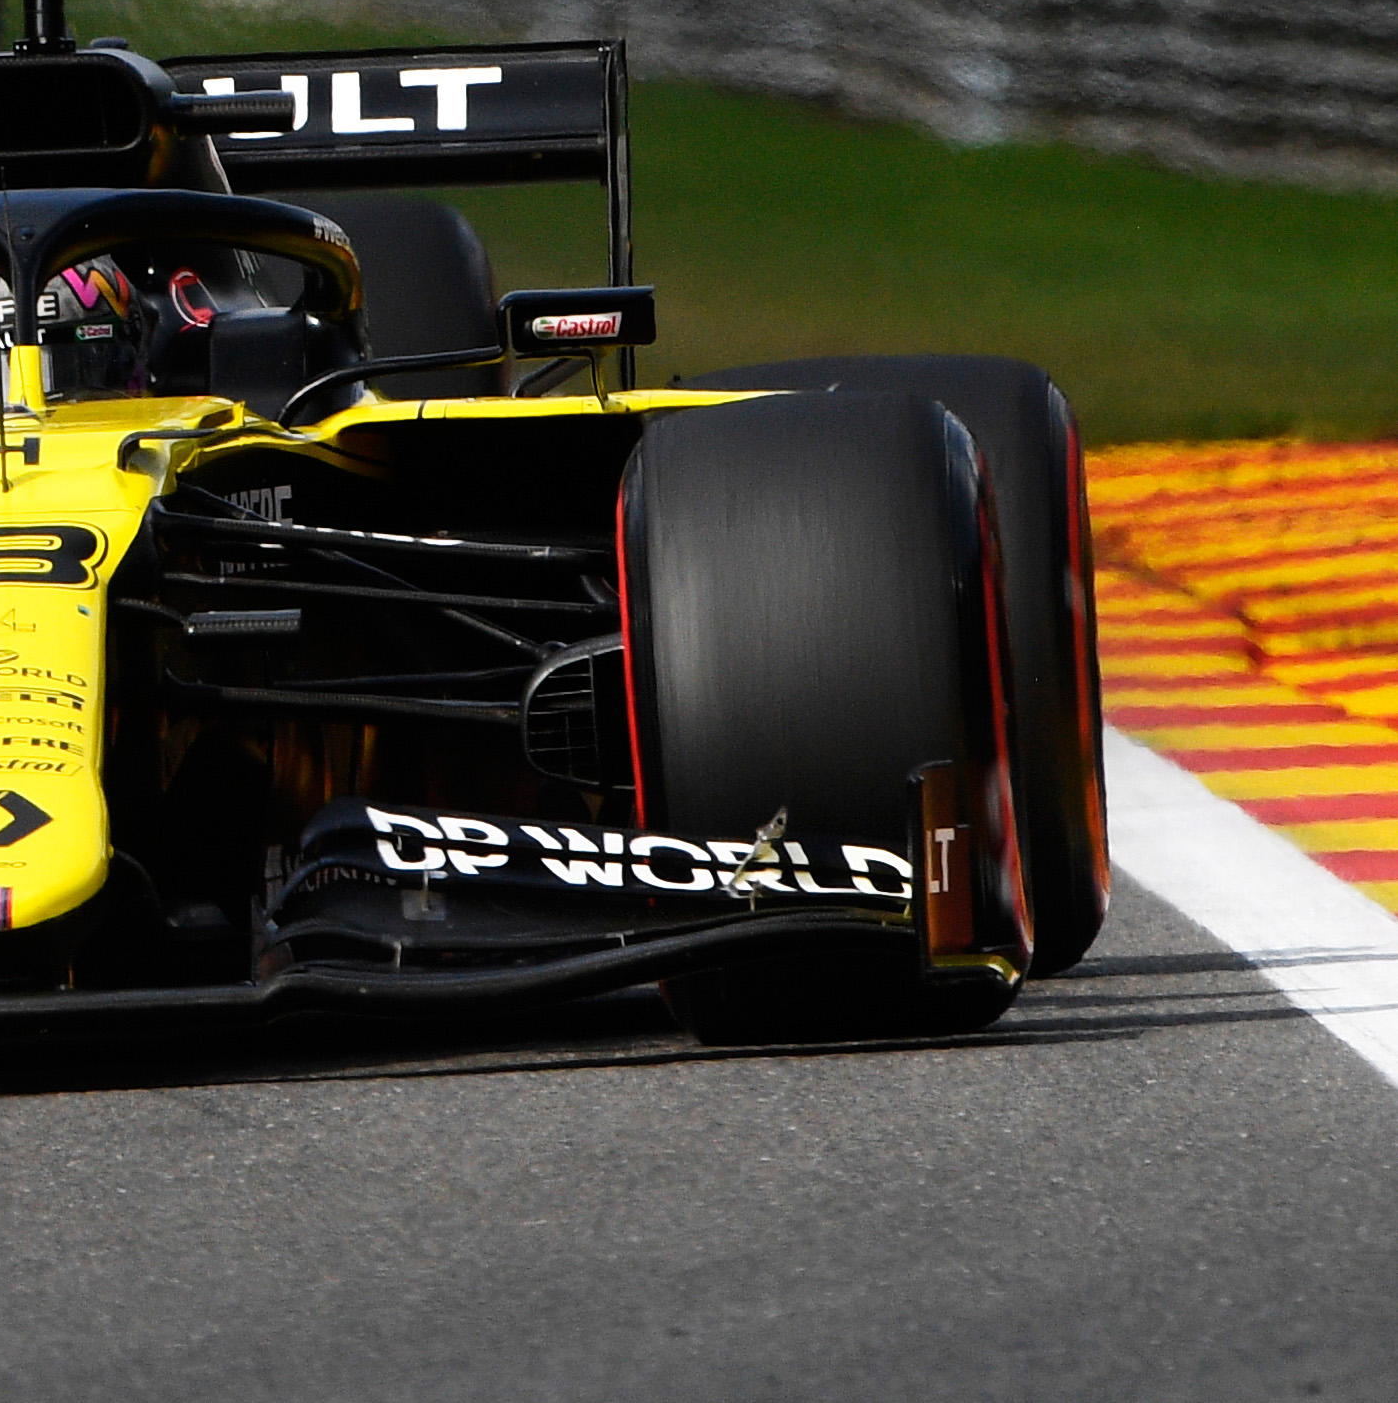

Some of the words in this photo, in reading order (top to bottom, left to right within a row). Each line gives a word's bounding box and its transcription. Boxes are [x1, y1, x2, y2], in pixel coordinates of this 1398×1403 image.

[556, 316, 617, 337] Castrol
[365, 805, 512, 875] DP
[519, 825, 913, 899] WORLD
